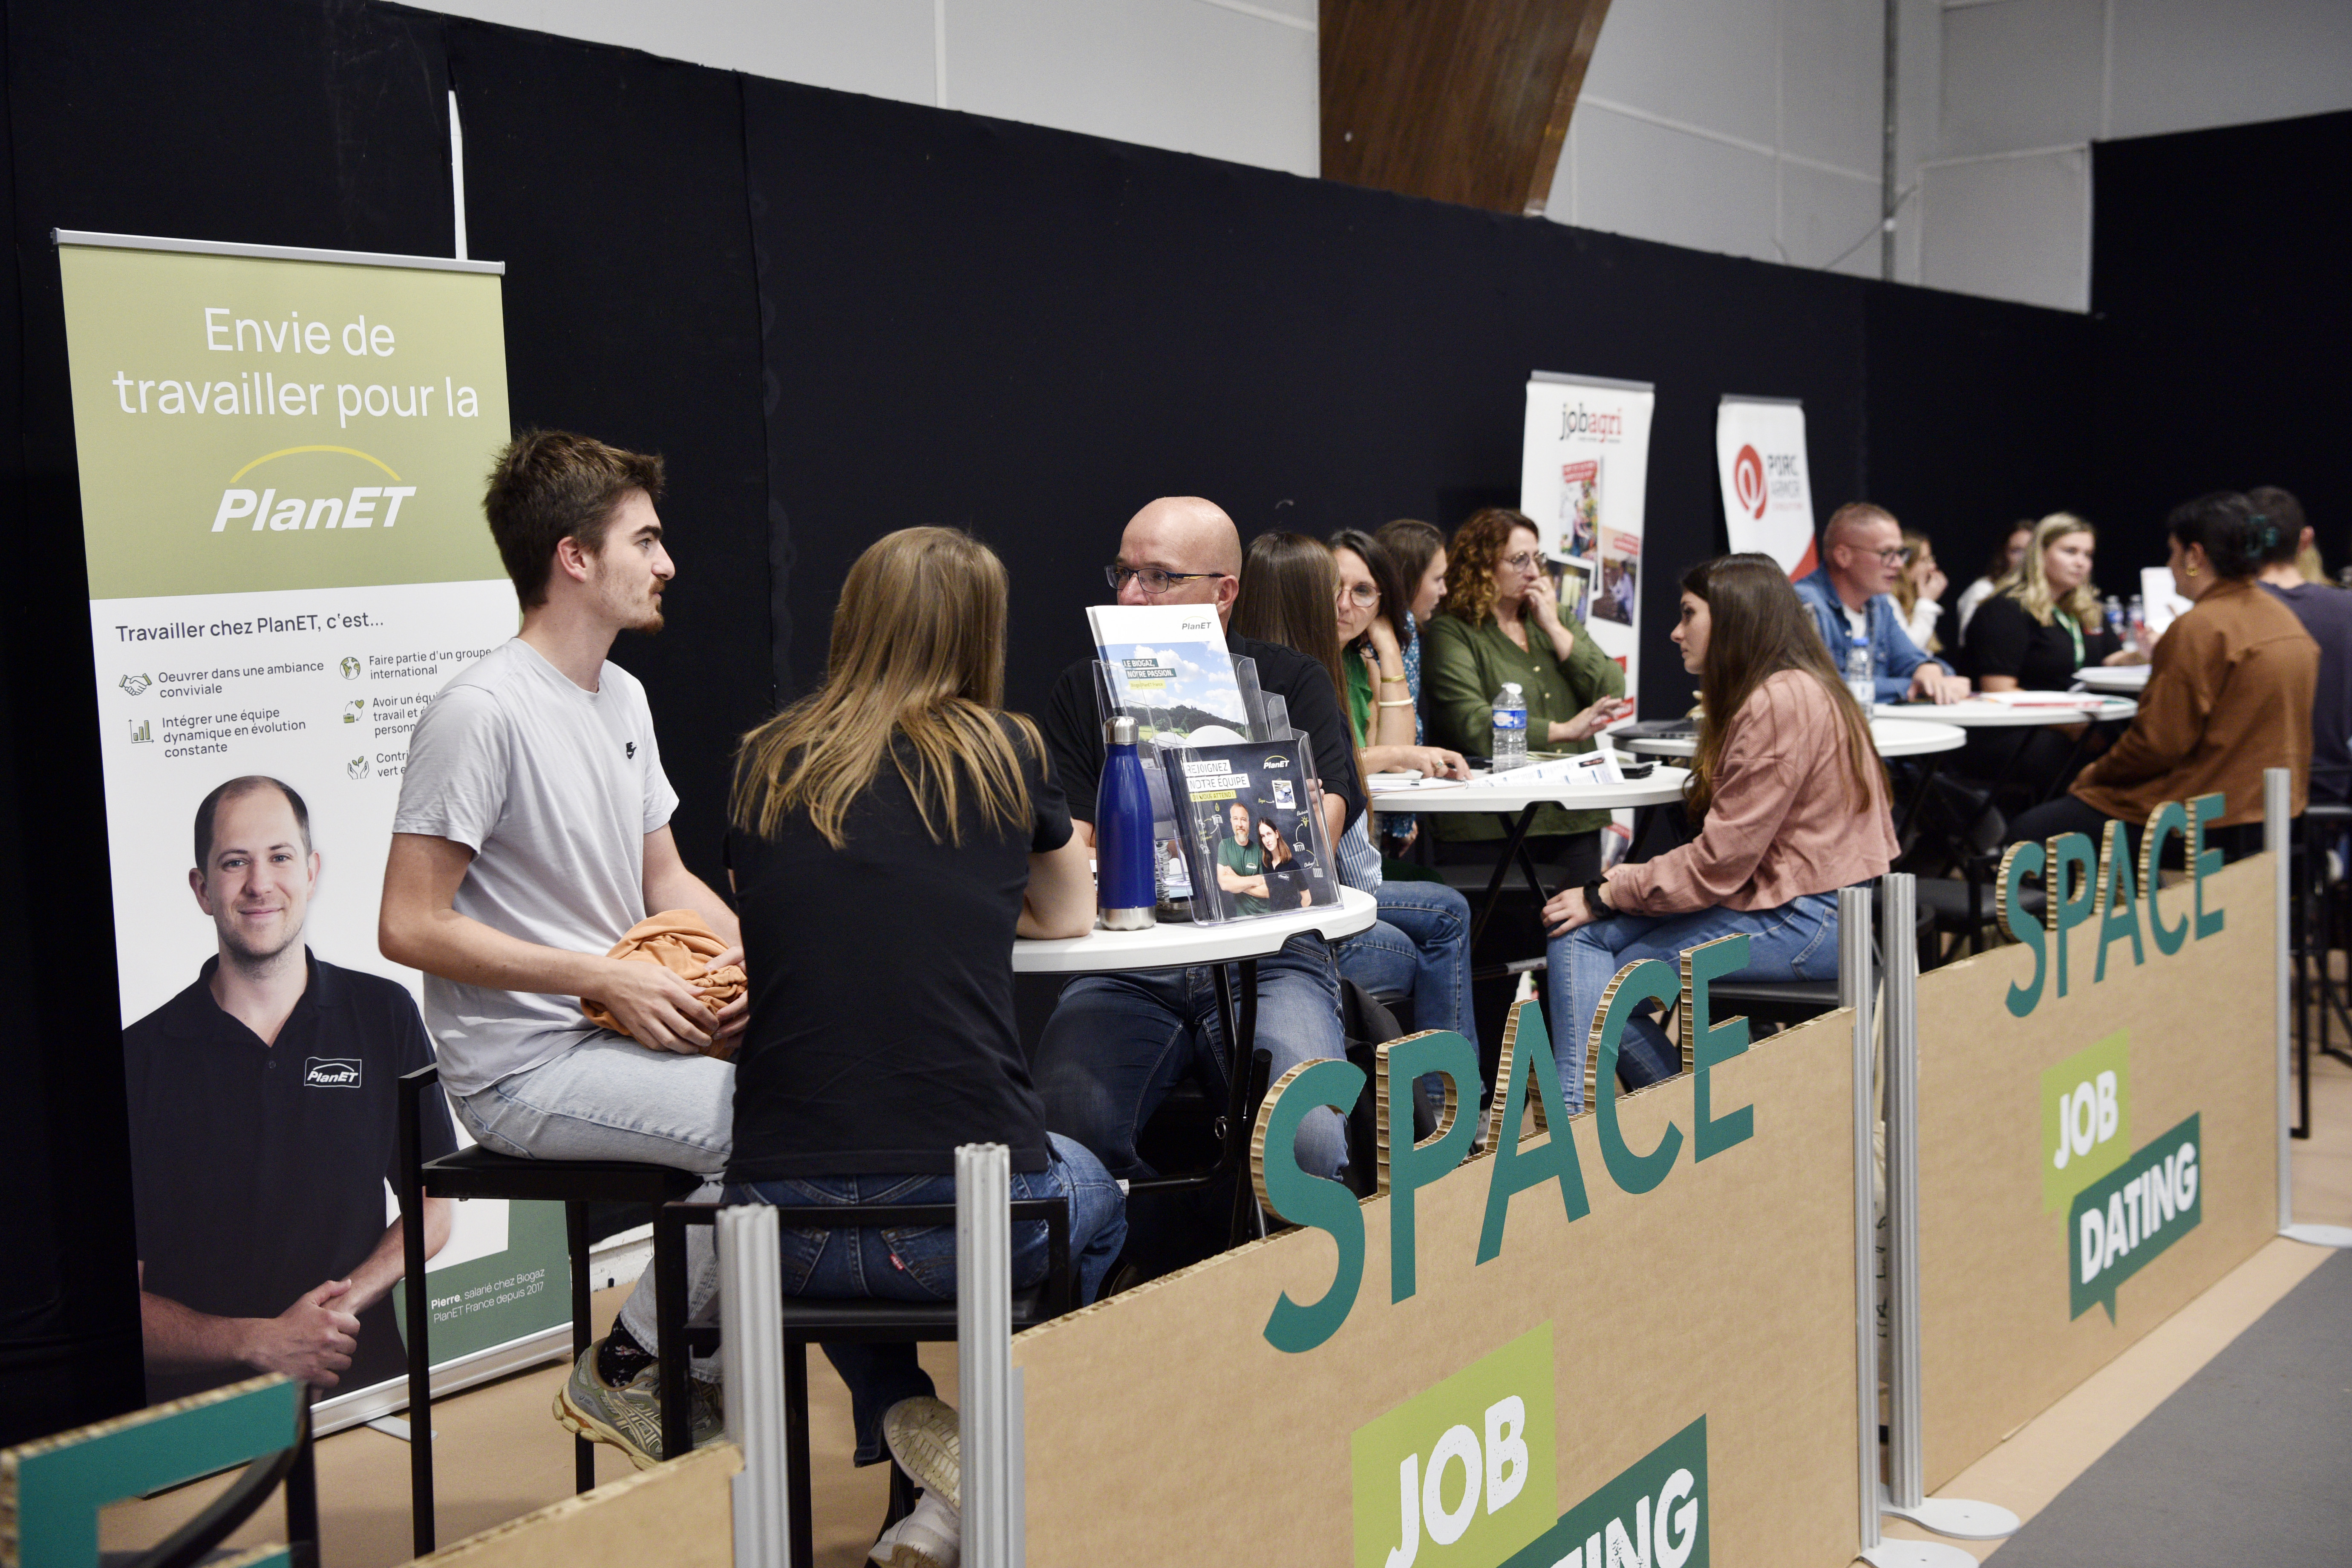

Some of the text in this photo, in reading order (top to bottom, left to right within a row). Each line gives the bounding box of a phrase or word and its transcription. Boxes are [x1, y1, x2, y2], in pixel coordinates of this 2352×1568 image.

[205, 308, 395, 357] Envie de
[112, 371, 478, 428] travailler pour la
[1559, 402, 1622, 443] jobagri
[1768, 454, 1799, 476] PORC
[212, 487, 417, 532] PlanET
[115, 623, 205, 641] Travailler
[210, 620, 253, 636] chez
[258, 615, 320, 632] PlanET,
[369, 649, 491, 666] Faire partie d'un groupe
[1132, 660, 1155, 668] BIOGAZ,
[159, 662, 324, 683] Oeuvrer dans une ambiance
[370, 665, 438, 680] international
[1127, 669, 1174, 678] NOTRE PASSION.
[160, 683, 222, 698] conviviale
[373, 696, 398, 707] Avoir
[401, 696, 413, 705] un
[162, 709, 280, 729] Intégrer une équipe
[374, 709, 404, 721] travail
[407, 709, 418, 718] et
[164, 720, 306, 745] dynamique en évolution
[375, 723, 416, 738] personn
[164, 743, 227, 758] constante
[376, 750, 408, 763] Contri
[378, 766, 398, 777] vert
[1187, 763, 1228, 774] REJOIGNEZ
[1263, 760, 1290, 769] PlanET
[1189, 775, 1247, 789] NOTRE ÉQUIPE
[1996, 792, 2226, 1017] SPACE
[307, 1070, 358, 1082] PlanET
[2054, 1070, 2119, 1169] JOB
[1251, 932, 1754, 1354] SPACE
[2080, 1142, 2198, 1284] DATING
[431, 1269, 545, 1309] Pierre, salarié chez Biogaz
[434, 1281, 544, 1323] PlanET France depuis 2017
[1386, 1395, 1528, 1568] JOB
